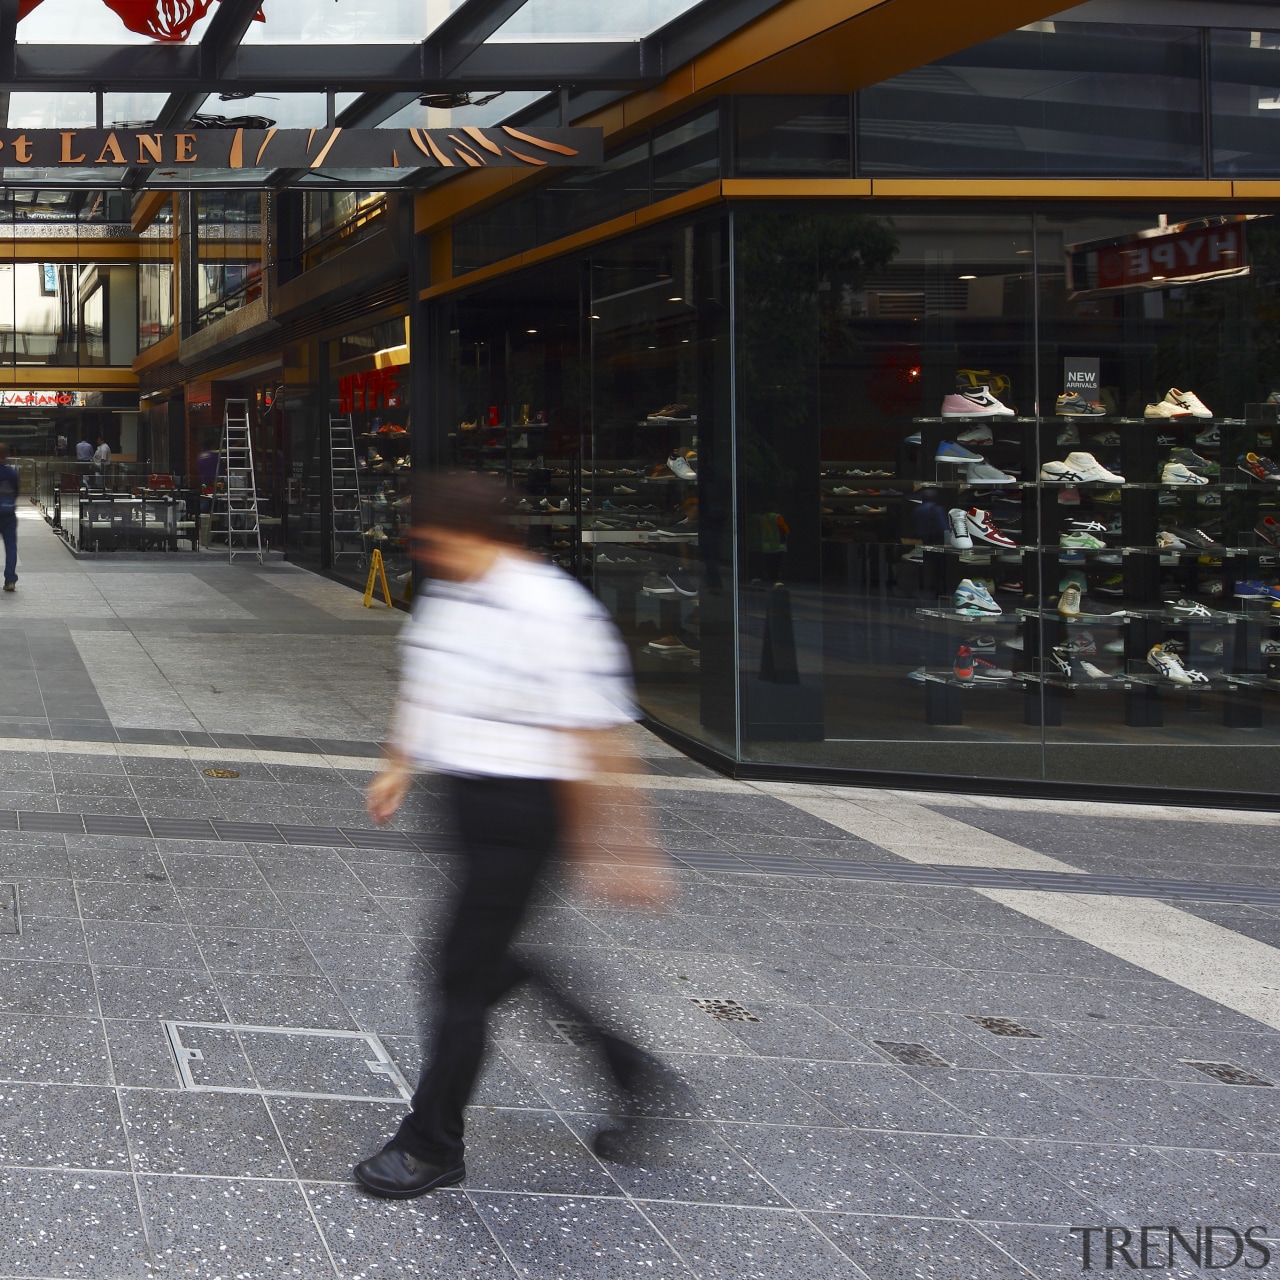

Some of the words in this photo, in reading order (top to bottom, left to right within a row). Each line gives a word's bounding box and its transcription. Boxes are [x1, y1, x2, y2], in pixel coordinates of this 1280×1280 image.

[58, 131, 199, 164] LANE
[339, 365, 400, 414] HYPE
[1068, 372, 1096, 382] NEW
